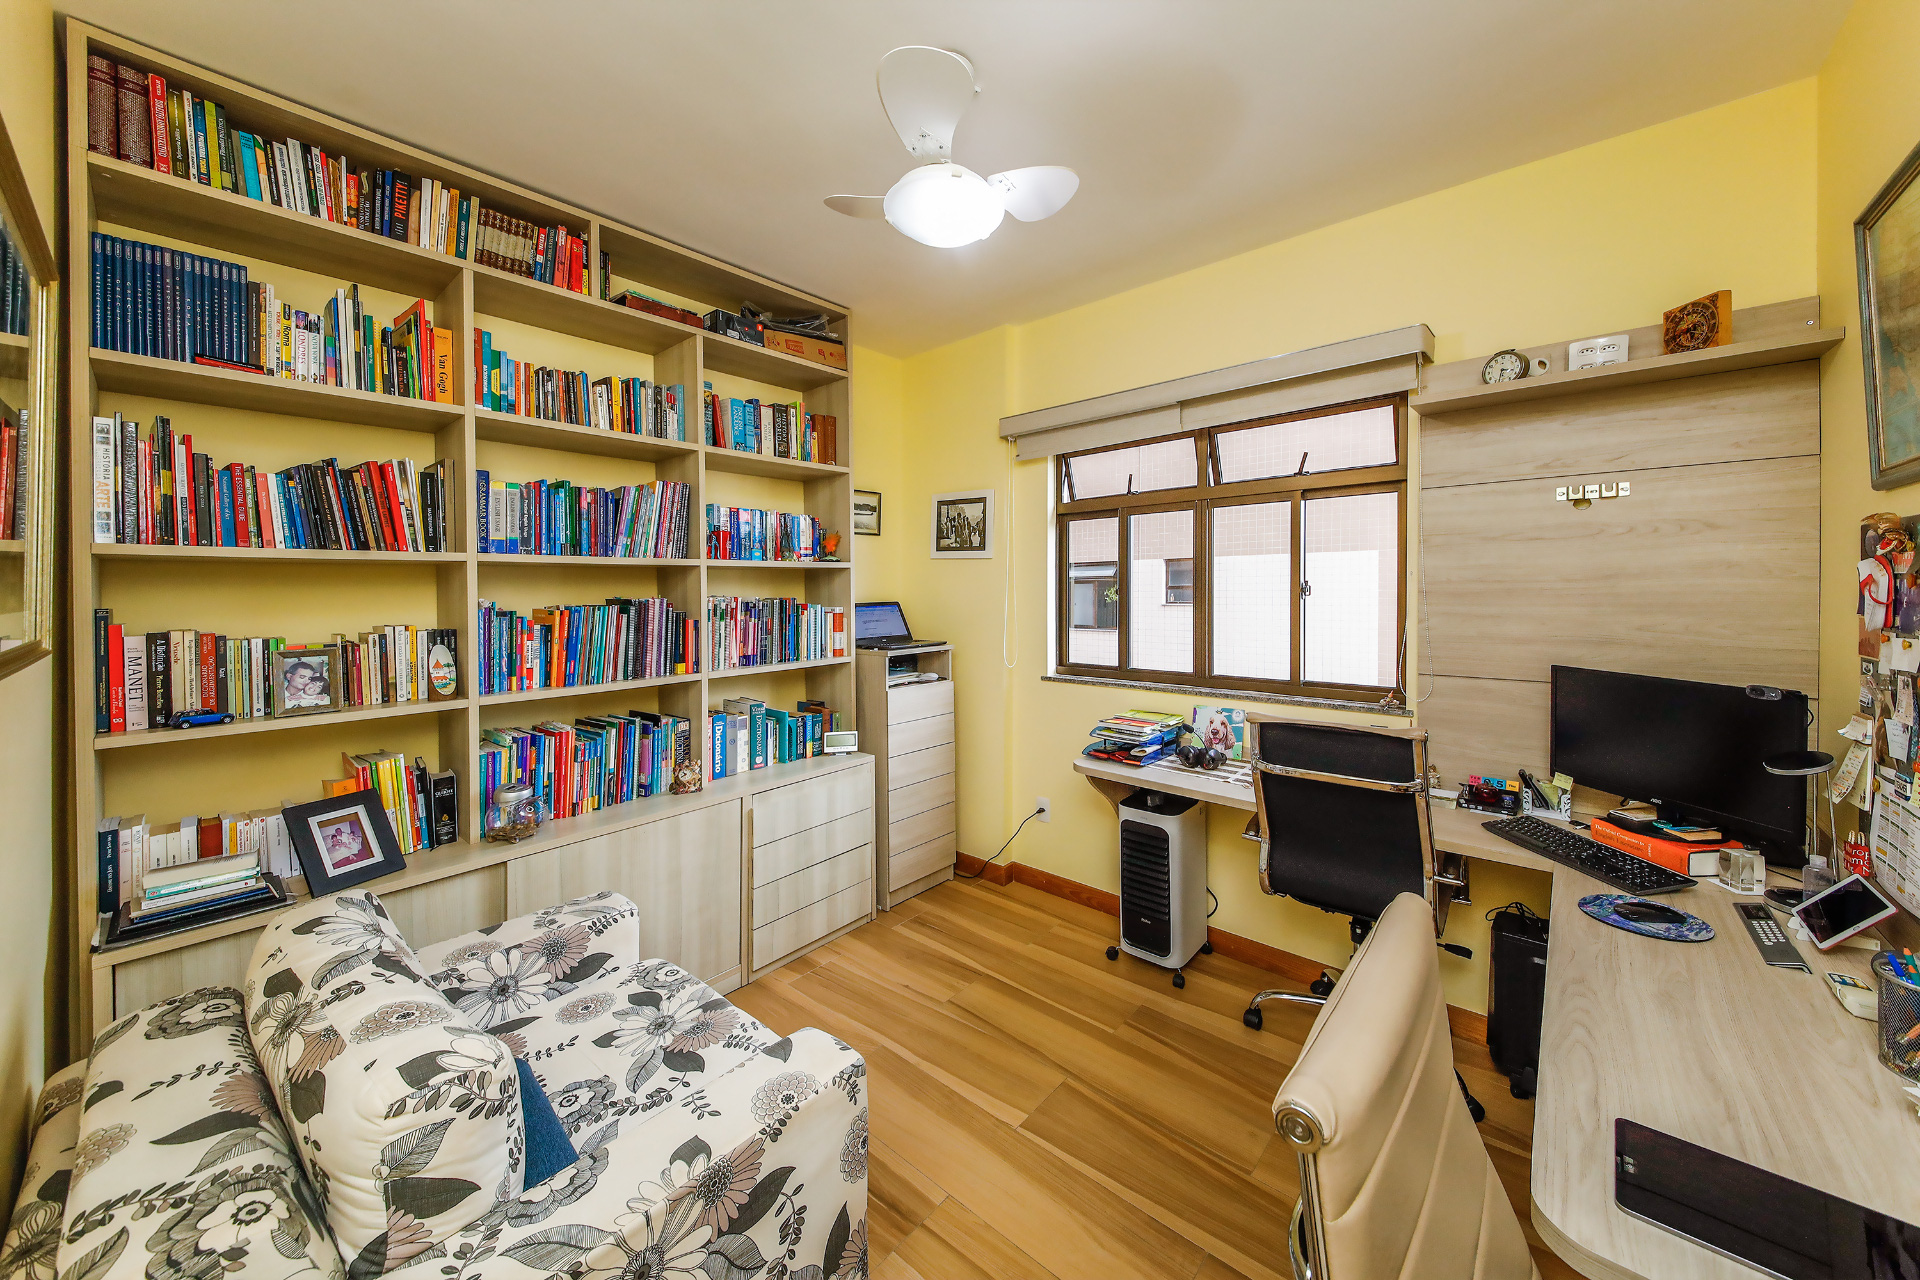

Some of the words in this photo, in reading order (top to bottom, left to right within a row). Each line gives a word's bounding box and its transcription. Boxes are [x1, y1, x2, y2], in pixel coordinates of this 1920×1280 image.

[394, 181, 407, 219] PIKETTY
[297, 330, 306, 364] LONDRES
[438, 352, 448, 371] Van
[436, 370, 448, 395] Gogh
[96, 480, 110, 508] ARTE
[235, 476, 244, 505] ESSENTIAL
[155, 644, 166, 671] Distinção
[127, 654, 143, 702] MANET
[715, 724, 723, 773] Dicionário
[1602, 827, 1616, 836] Oxford
[1616, 831, 1638, 845] Companion
